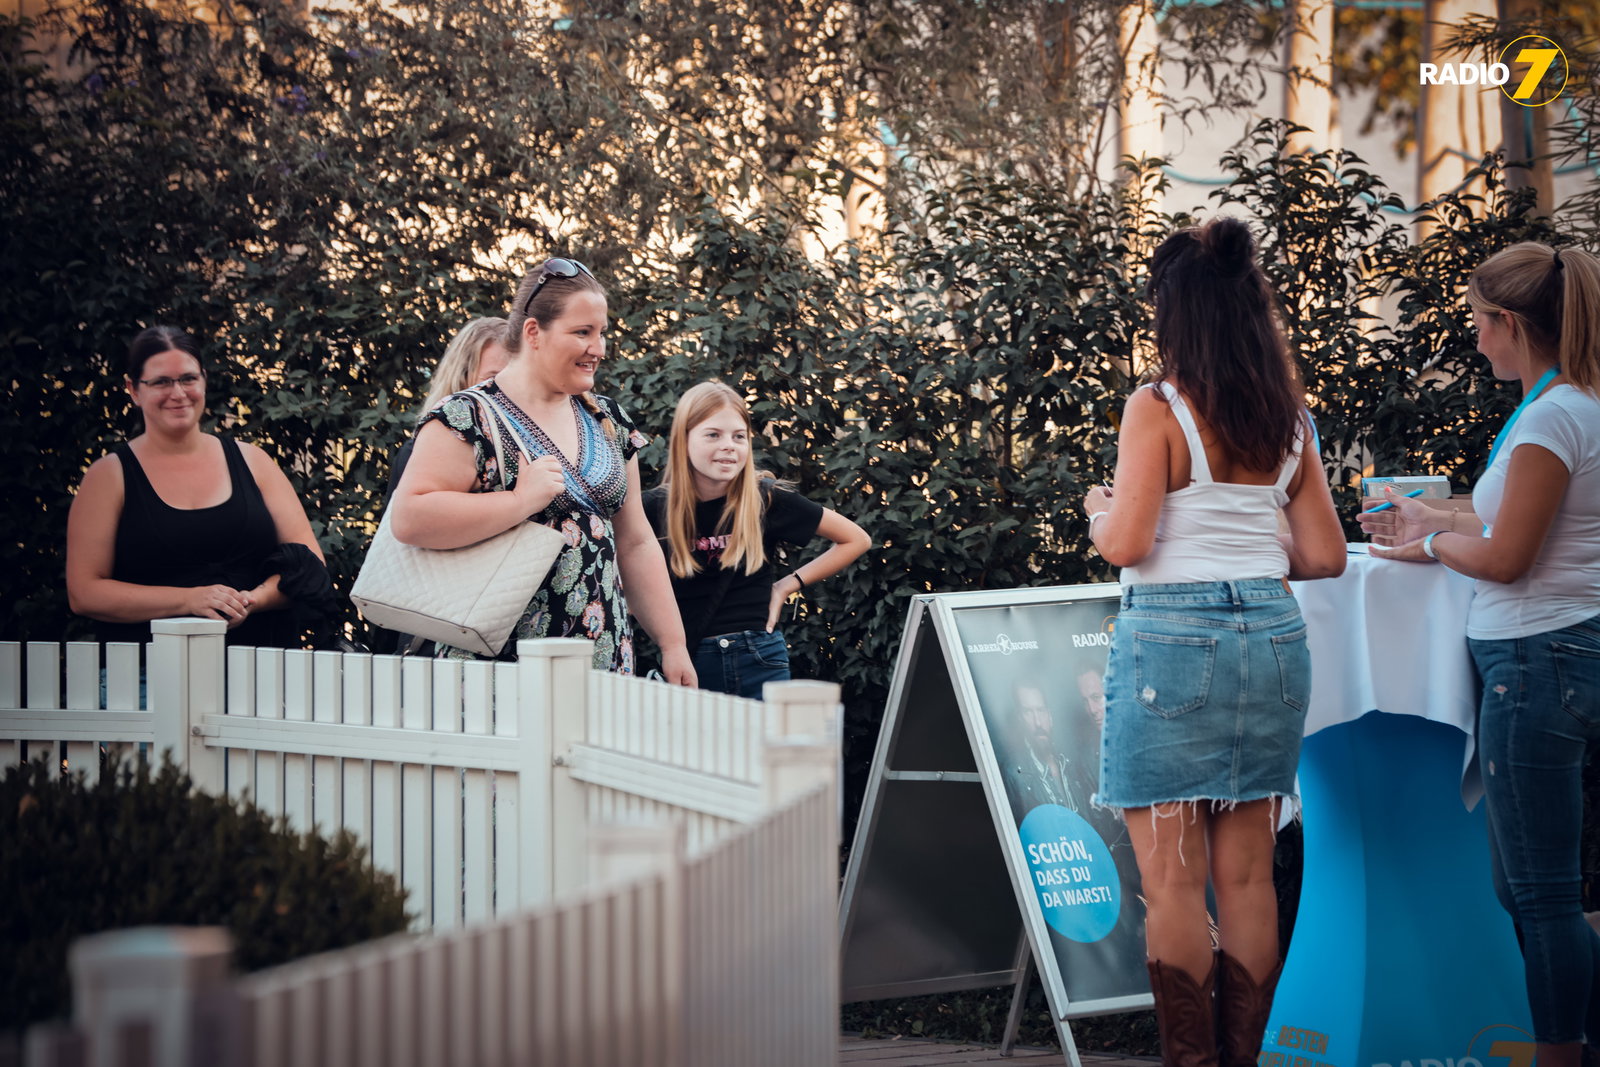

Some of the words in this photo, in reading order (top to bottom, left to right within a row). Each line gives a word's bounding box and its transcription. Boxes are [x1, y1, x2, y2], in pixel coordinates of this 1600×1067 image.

[1010, 640, 1039, 650] HOUSE
[1071, 632, 1110, 648] RADIO
[1028, 836, 1093, 865] SCHÖN,
[1035, 868, 1070, 887] DASS
[1071, 866, 1091, 883] DU
[1042, 892, 1063, 909] DA
[1062, 886, 1112, 906] WARST!
[1277, 1025, 1329, 1055] BESTEN
